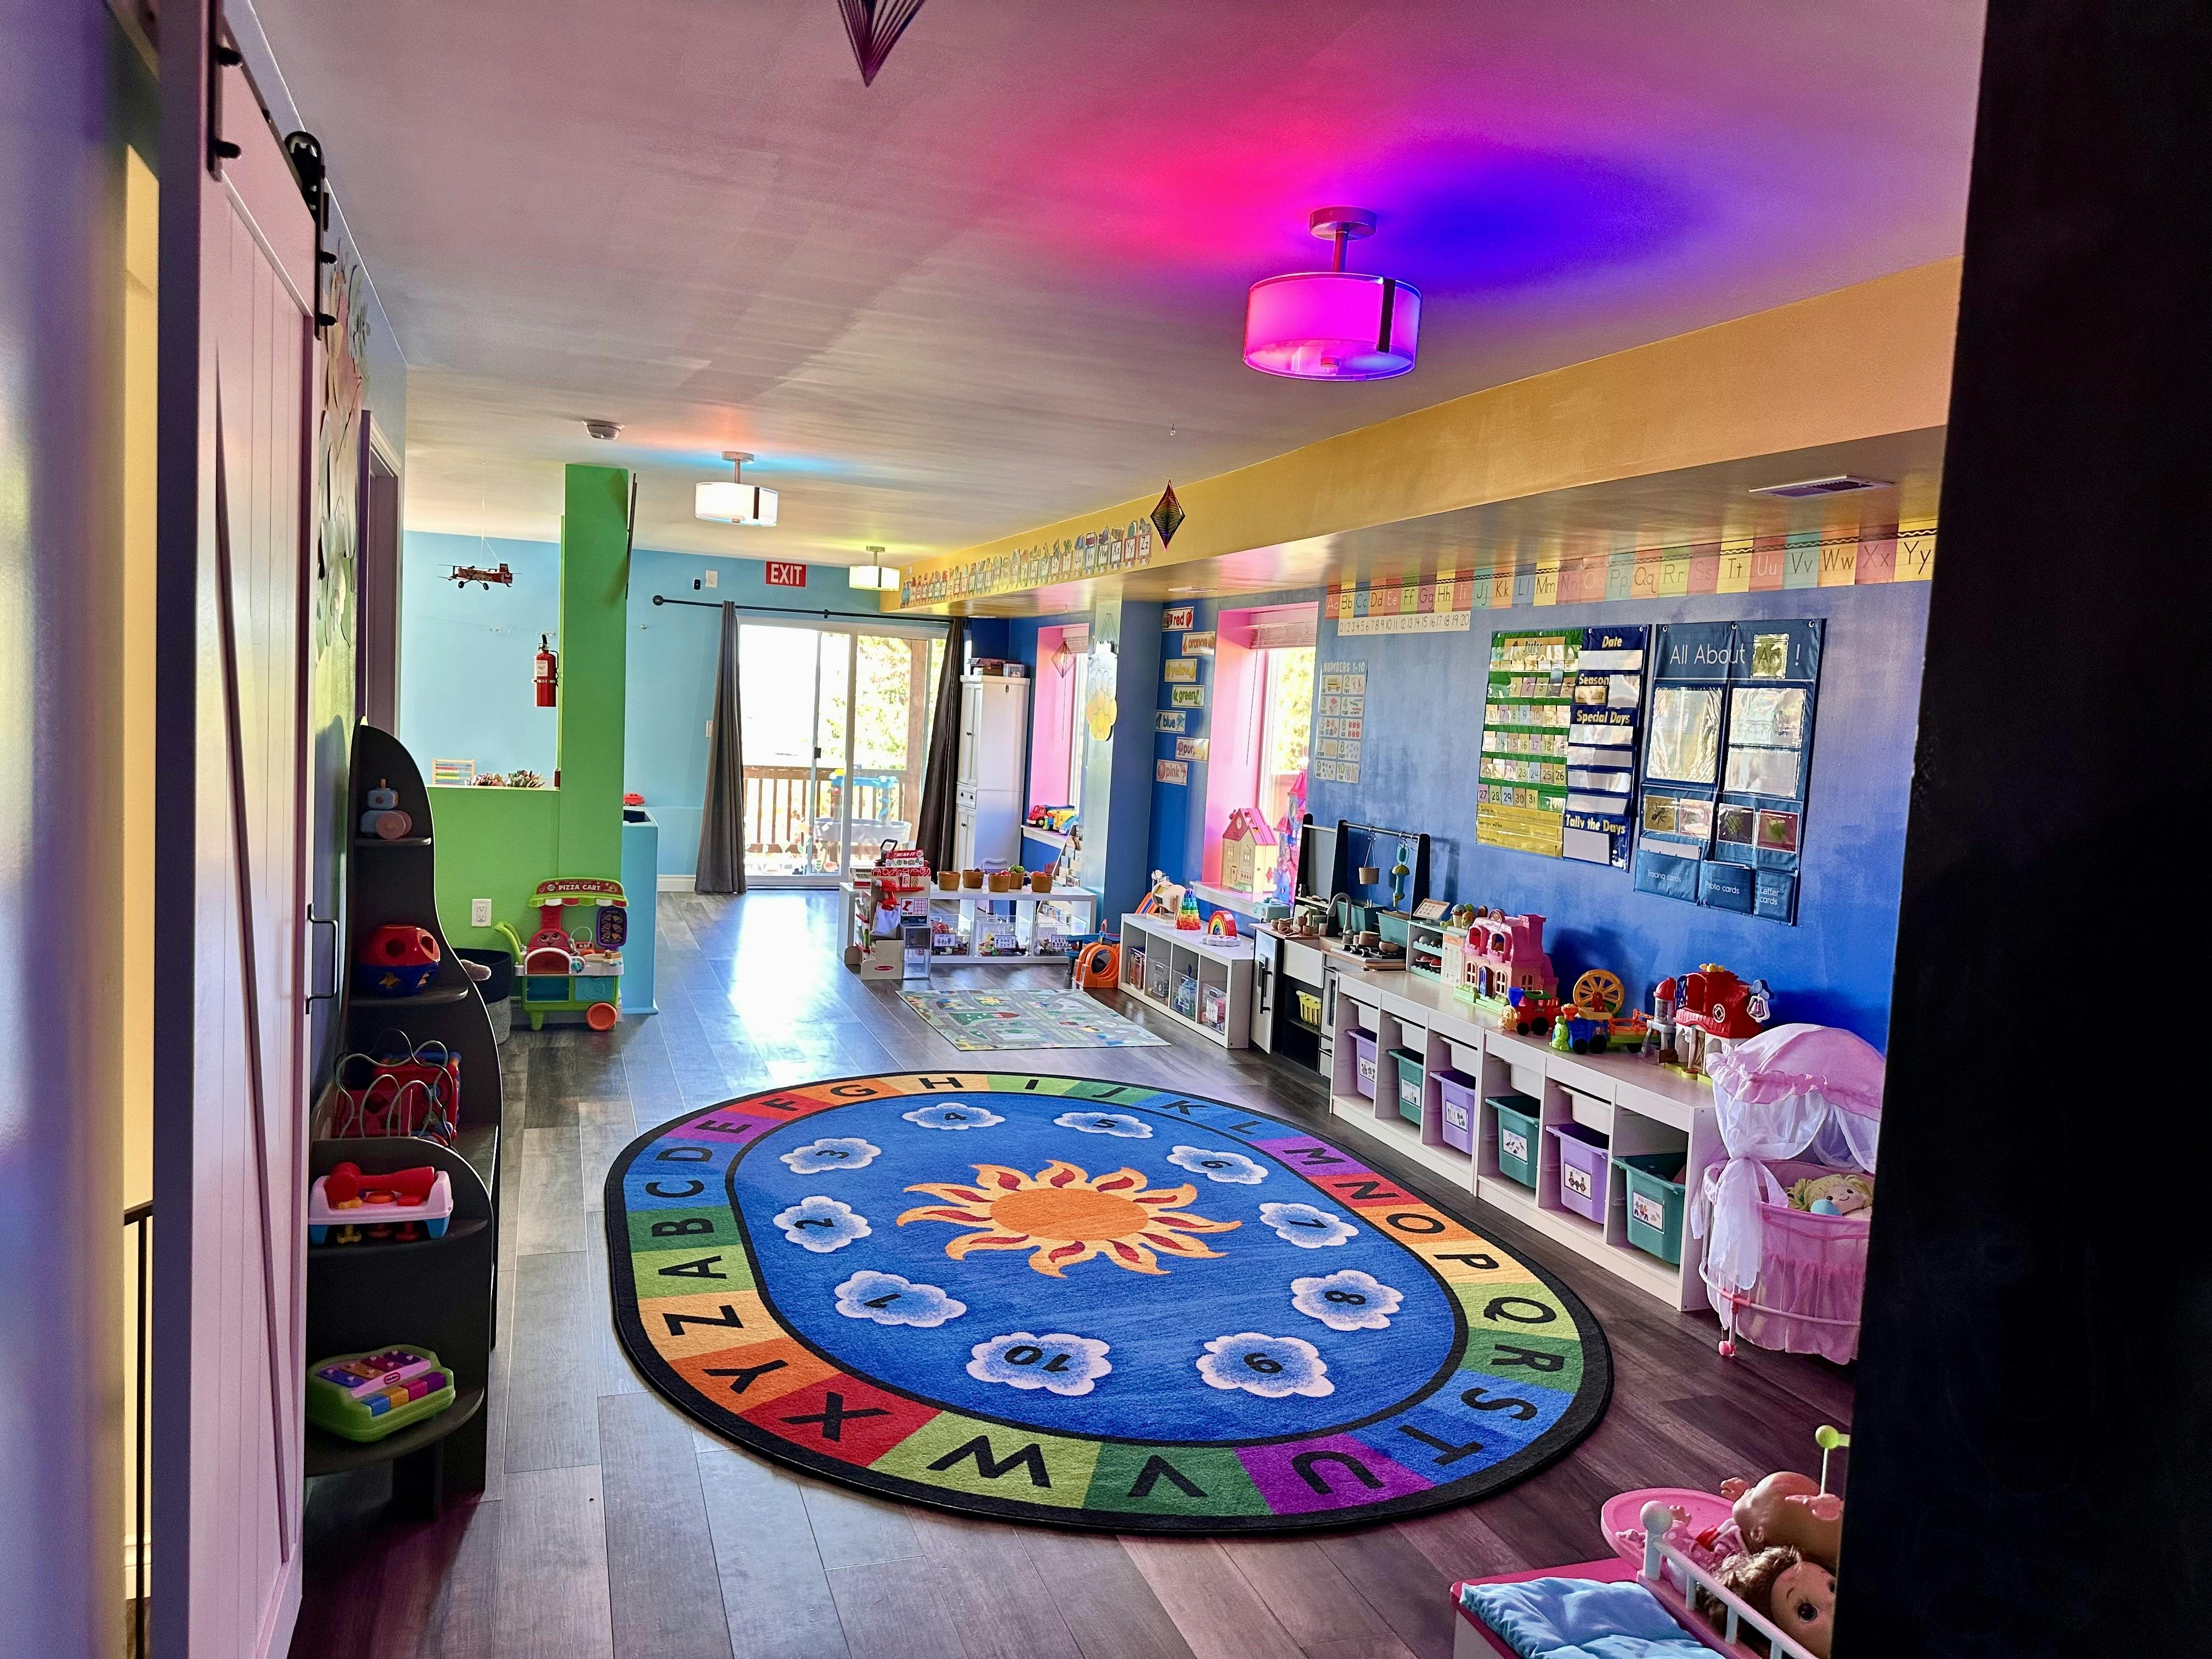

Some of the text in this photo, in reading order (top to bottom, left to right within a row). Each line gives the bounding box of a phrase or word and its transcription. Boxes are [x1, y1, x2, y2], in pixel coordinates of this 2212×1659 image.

[1127, 540, 1133, 557] Yy
[1141, 536, 1148, 550] Zz
[770, 563, 802, 585] EXIT
[1327, 597, 1339, 610] Aa
[1341, 595, 1352, 609] Bb
[1356, 594, 1368, 607] Cc
[1371, 592, 1383, 607] Dd
[1387, 591, 1397, 606] Ee
[1404, 589, 1414, 605] Ff
[1419, 588, 1434, 610] Gg
[1438, 586, 1450, 602] Hh
[1459, 585, 1466, 600] Ii
[1476, 582, 1488, 606] Jj
[1496, 580, 1509, 597] Kk
[1536, 576, 1555, 594] Mm
[1561, 576, 1577, 592] Nn
[1609, 569, 1628, 596] Pp
[1634, 567, 1657, 593] Qq
[1663, 564, 1684, 584] Rr
[1696, 561, 1712, 580] Ss
[1728, 558, 1742, 579] Tt
[1757, 555, 1777, 576] Uu
[1792, 552, 1812, 573] Vv
[1823, 549, 1854, 571] Ww
[1863, 544, 1890, 568] Xx
[1904, 540, 1932, 575] Yy
[1173, 612, 1184, 626] red
[1523, 639, 1544, 656] July
[1602, 636, 1622, 648] Date
[1670, 644, 1688, 665] All
[1694, 644, 1746, 665] About
[1171, 663, 1190, 678] yellow
[1323, 662, 1365, 673] NUMBERS 1-10
[1345, 675, 1350, 687] 2
[1579, 674, 1610, 685] Season
[1179, 690, 1195, 703] green
[1163, 715, 1175, 728] blue
[1577, 710, 1630, 725] Special Days
[1520, 740, 1527, 750] 16
[1165, 765, 1179, 779] pink
[1518, 768, 1564, 780] 23 24 25 26
[1479, 790, 1536, 804] 27 28 29 30 31
[1566, 815, 1626, 835] Tally the Days
[1647, 869, 1681, 883] Tracing cards
[1705, 881, 1740, 894] Photo cards
[1760, 887, 1779, 896] Letter
[1759, 896, 1778, 905] cards
[1093, 1119, 1119, 1128] 5
[815, 1150, 849, 1159] 3
[794, 1218, 834, 1229] 2
[1287, 1219, 1328, 1228] 7
[645, 1076, 1564, 1497] A B C D E F G H I J K L M N O P Q R S T U V W X Y Z
[1325, 1291, 1366, 1305] 8
[1004, 1346, 1071, 1372] 10
